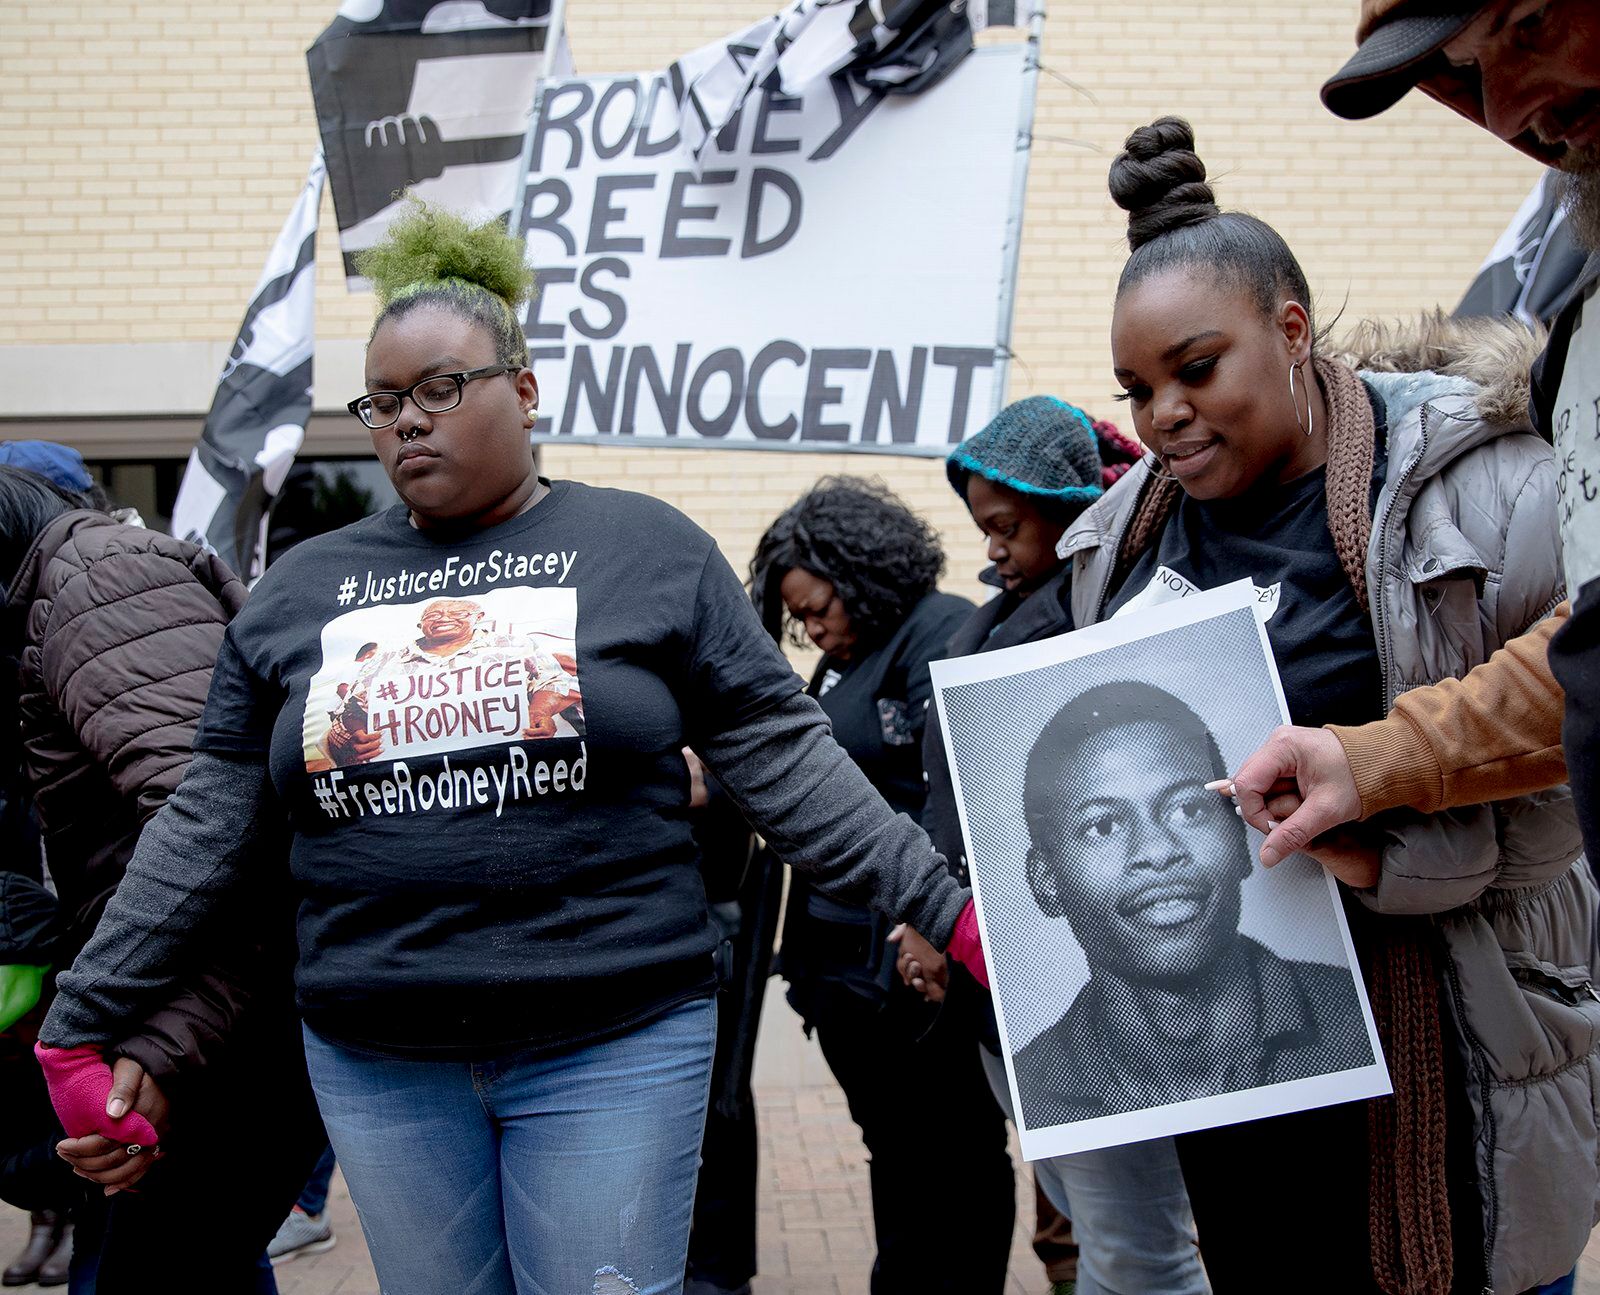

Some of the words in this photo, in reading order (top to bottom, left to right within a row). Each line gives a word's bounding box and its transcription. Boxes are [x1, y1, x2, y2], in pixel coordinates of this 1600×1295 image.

[519, 168, 803, 259] REED
[523, 257, 631, 340] IS
[337, 550, 578, 606] #JusticeForStacey
[1156, 570, 1195, 598] NOT
[376, 659, 523, 705] #JUSTICE
[372, 694, 523, 746] 4RODNEY
[314, 741, 588, 818] #FreeRodneyReed
